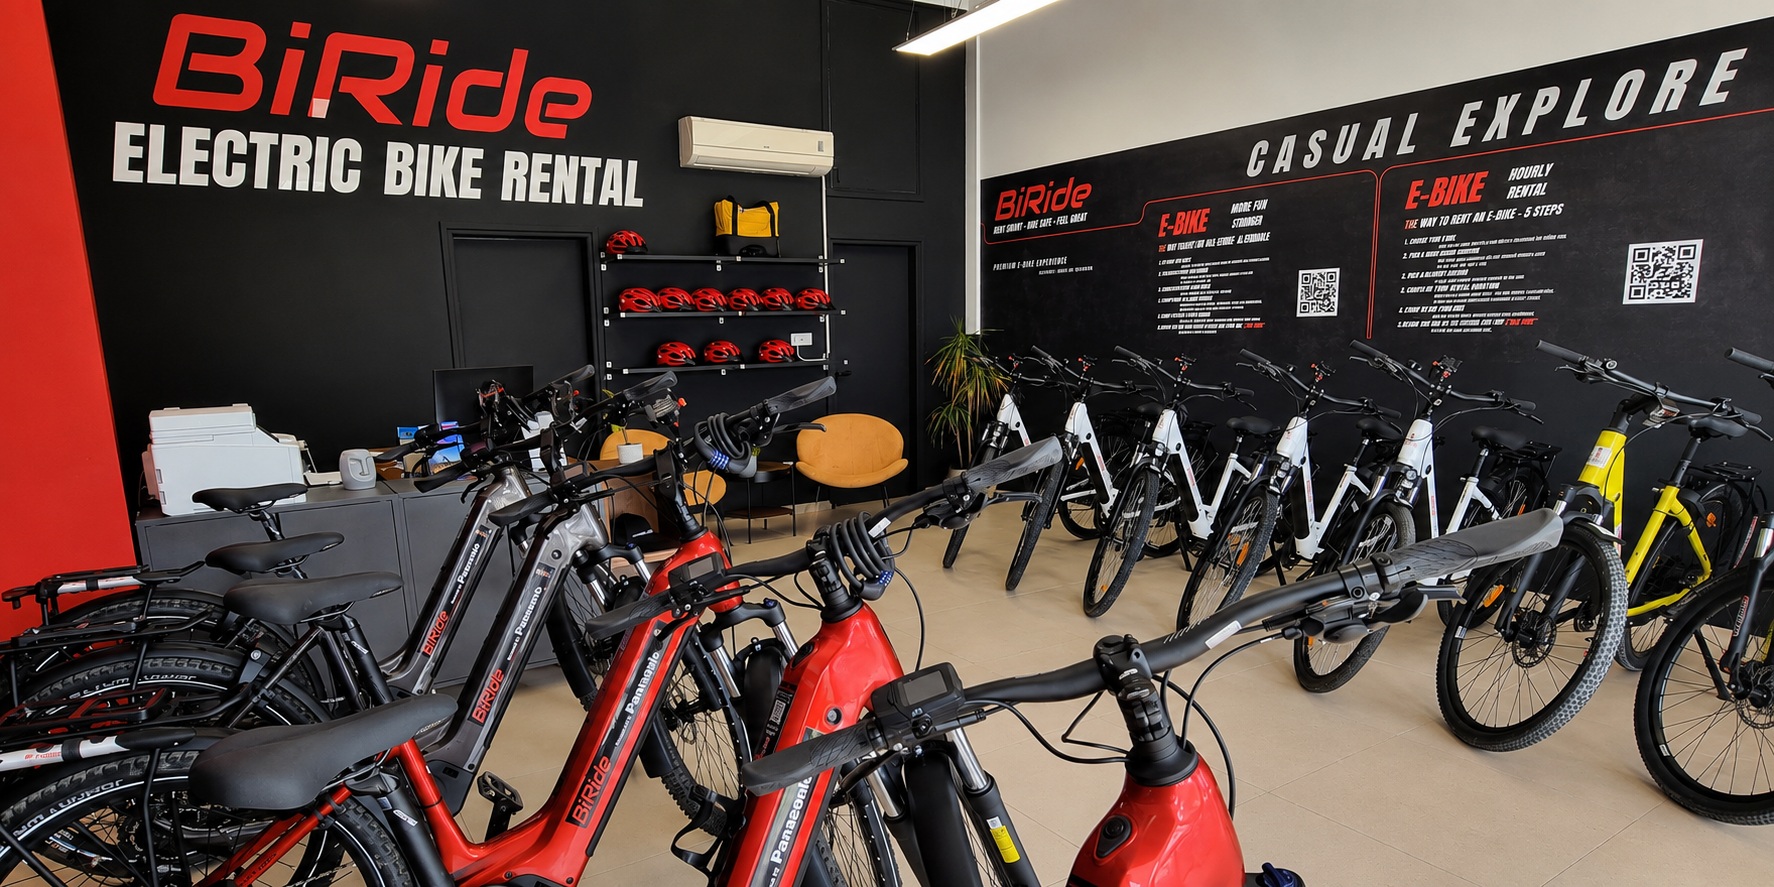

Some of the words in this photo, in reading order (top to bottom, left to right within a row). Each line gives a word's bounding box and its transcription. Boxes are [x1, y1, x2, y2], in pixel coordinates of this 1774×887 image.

[153, 13, 592, 139] BiRide
[1246, 112, 1419, 177] CASUAL
[1450, 48, 1748, 148] EXPLORE
[113, 121, 362, 193] ELECTRIC
[384, 141, 484, 199] BIKE
[500, 150, 643, 207] RENTAL
[1507, 162, 1555, 182] HOURLY
[995, 177, 1092, 221] BiRide
[1405, 171, 1489, 210] E-BIKE
[1506, 182, 1548, 200] RENTAL
[1158, 208, 1211, 238] E-BIKE
[1420, 217, 1437, 229] WAY
[1439, 215, 1450, 227] TO
[1450, 213, 1473, 225] RENT
[1486, 208, 1517, 222] E-BIKE
[1523, 206, 1532, 218] 5
[1533, 203, 1565, 217] STEPS
[572, 756, 611, 825] BiRide
